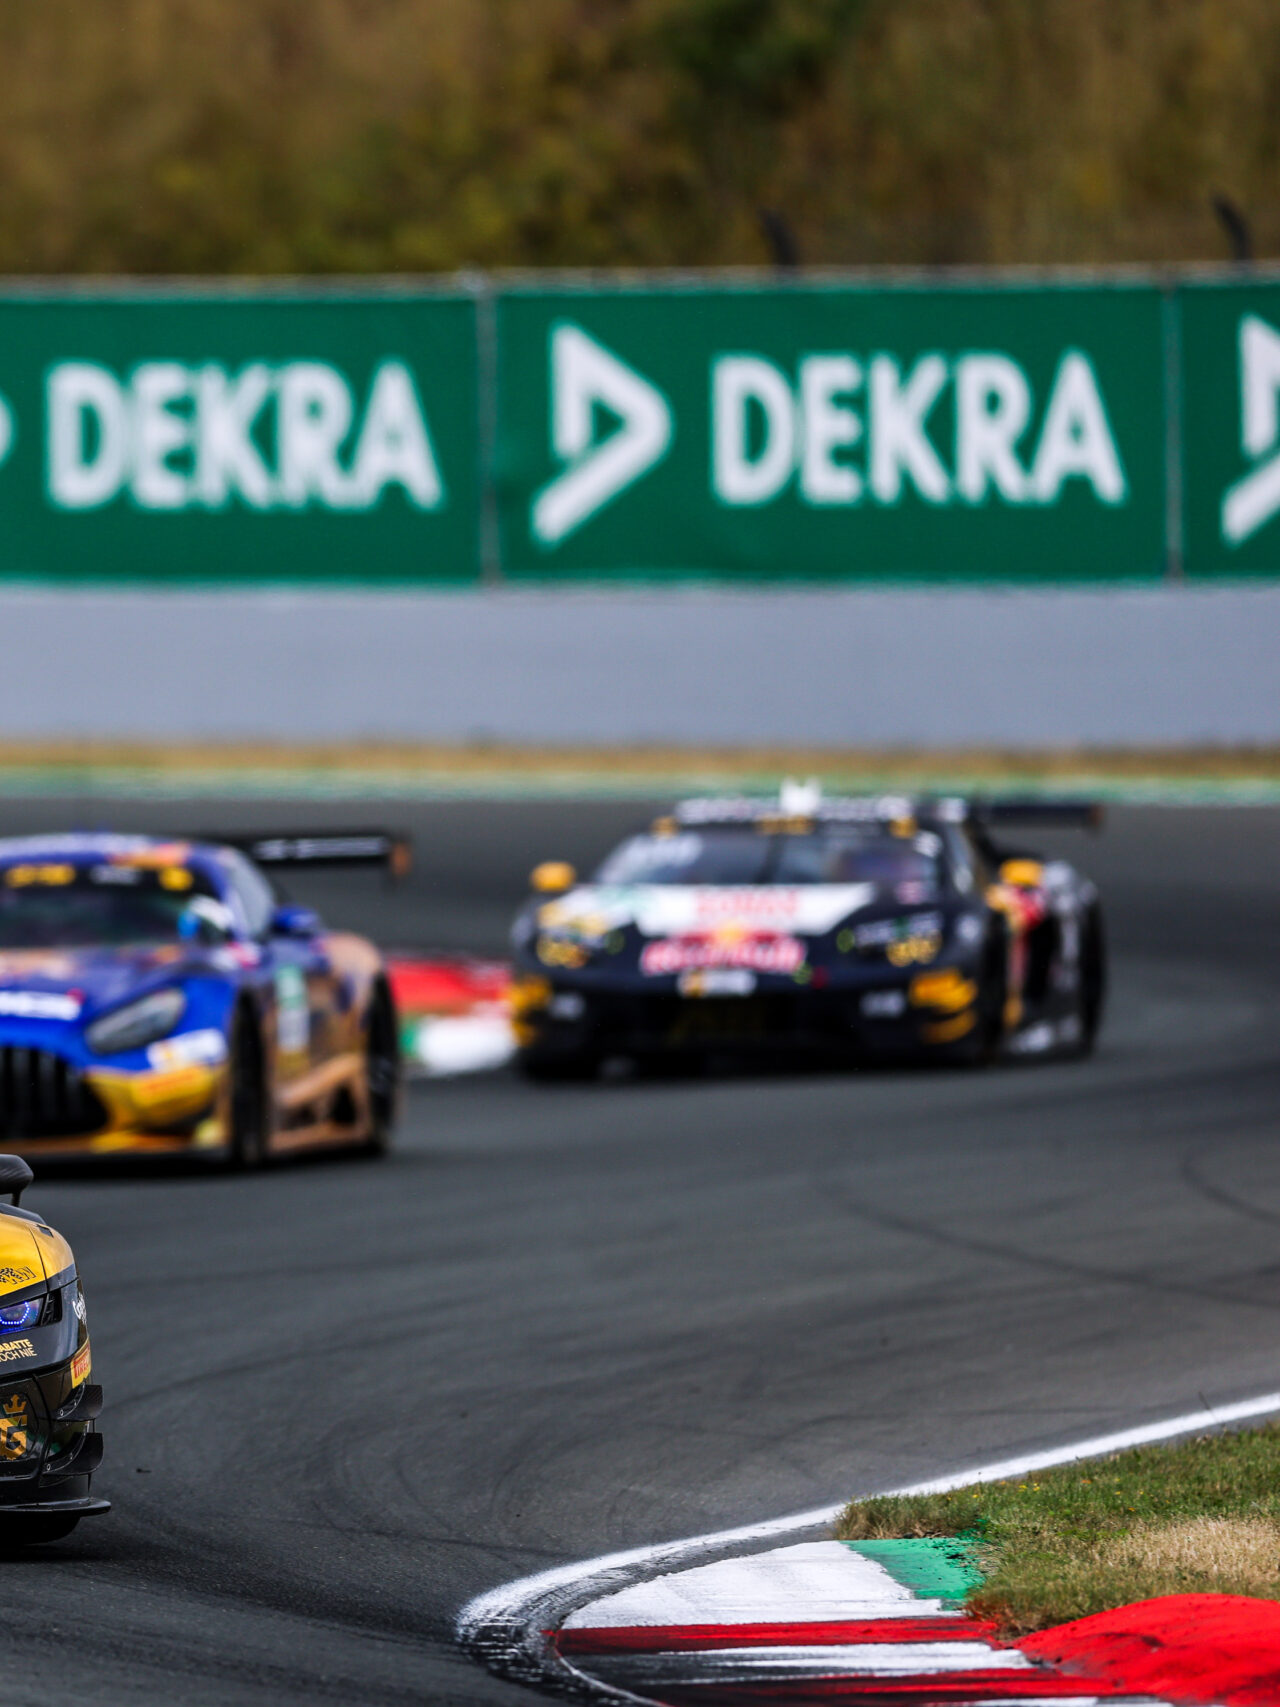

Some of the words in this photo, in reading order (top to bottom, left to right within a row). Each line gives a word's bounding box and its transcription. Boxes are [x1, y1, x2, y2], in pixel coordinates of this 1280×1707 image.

[46, 356, 444, 511] DEKRA
[712, 347, 1126, 506] DEKRA
[18, 1347, 38, 1358] NIE
